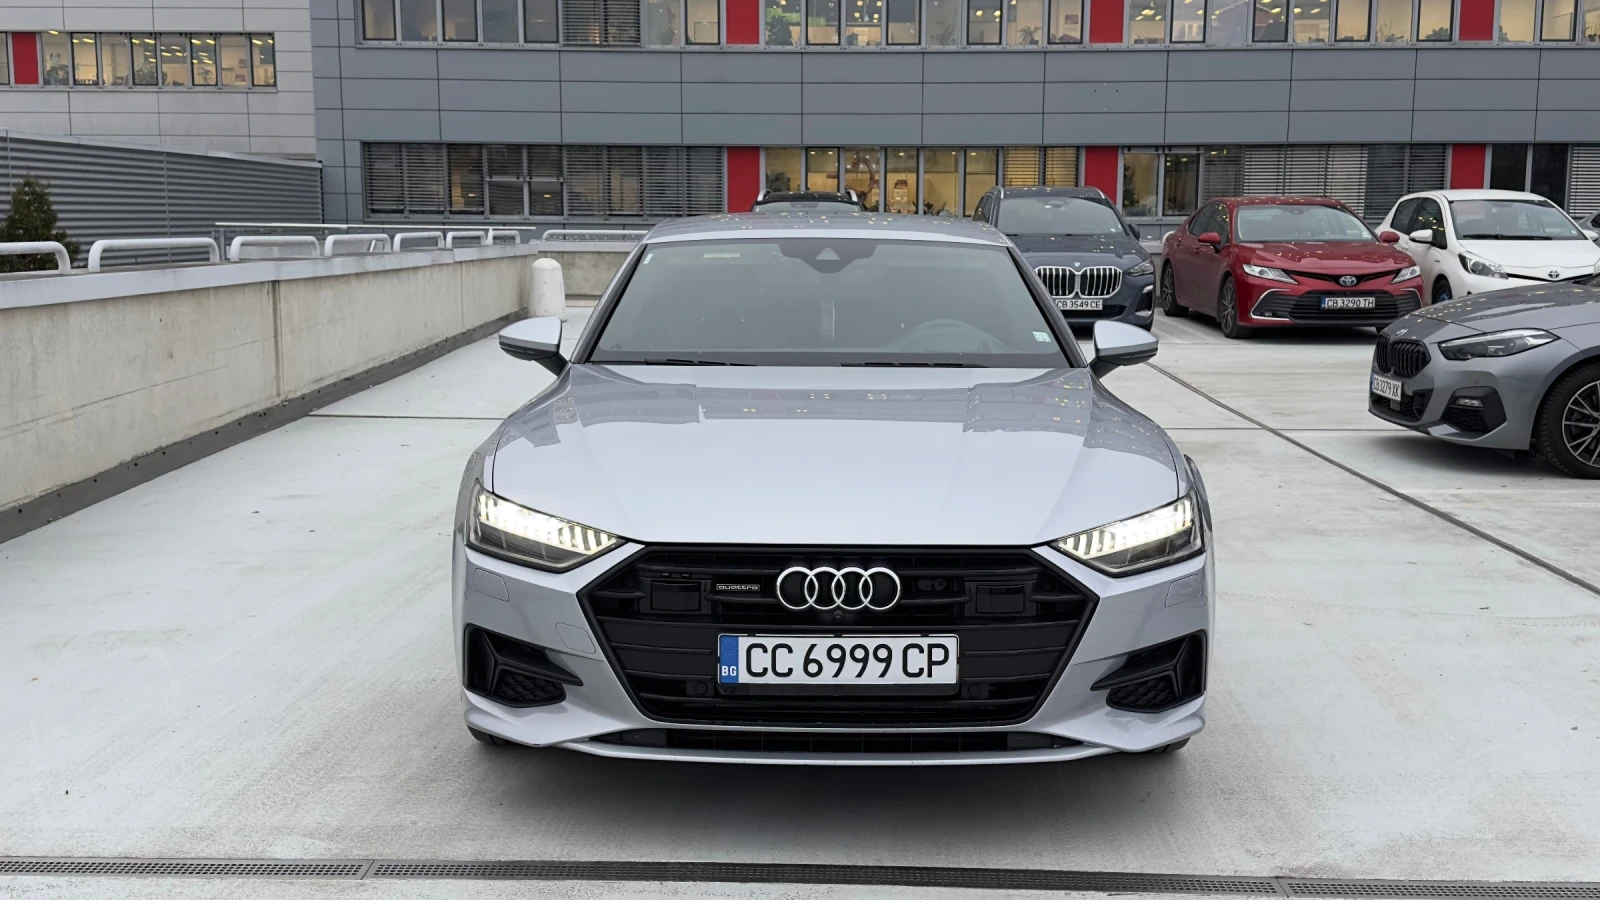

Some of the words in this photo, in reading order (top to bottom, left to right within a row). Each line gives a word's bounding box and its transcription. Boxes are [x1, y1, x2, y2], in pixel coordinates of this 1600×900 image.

[1057, 300, 1068, 308] CB
[1069, 300, 1089, 308] 3549
[1090, 300, 1101, 308] CE
[1327, 298, 1339, 307] CB
[1340, 298, 1361, 307] 3290
[1362, 298, 1374, 307] TH
[745, 642, 794, 678] CC
[802, 642, 893, 678] 6999
[902, 642, 950, 678] CP
[721, 665, 737, 677] BG
